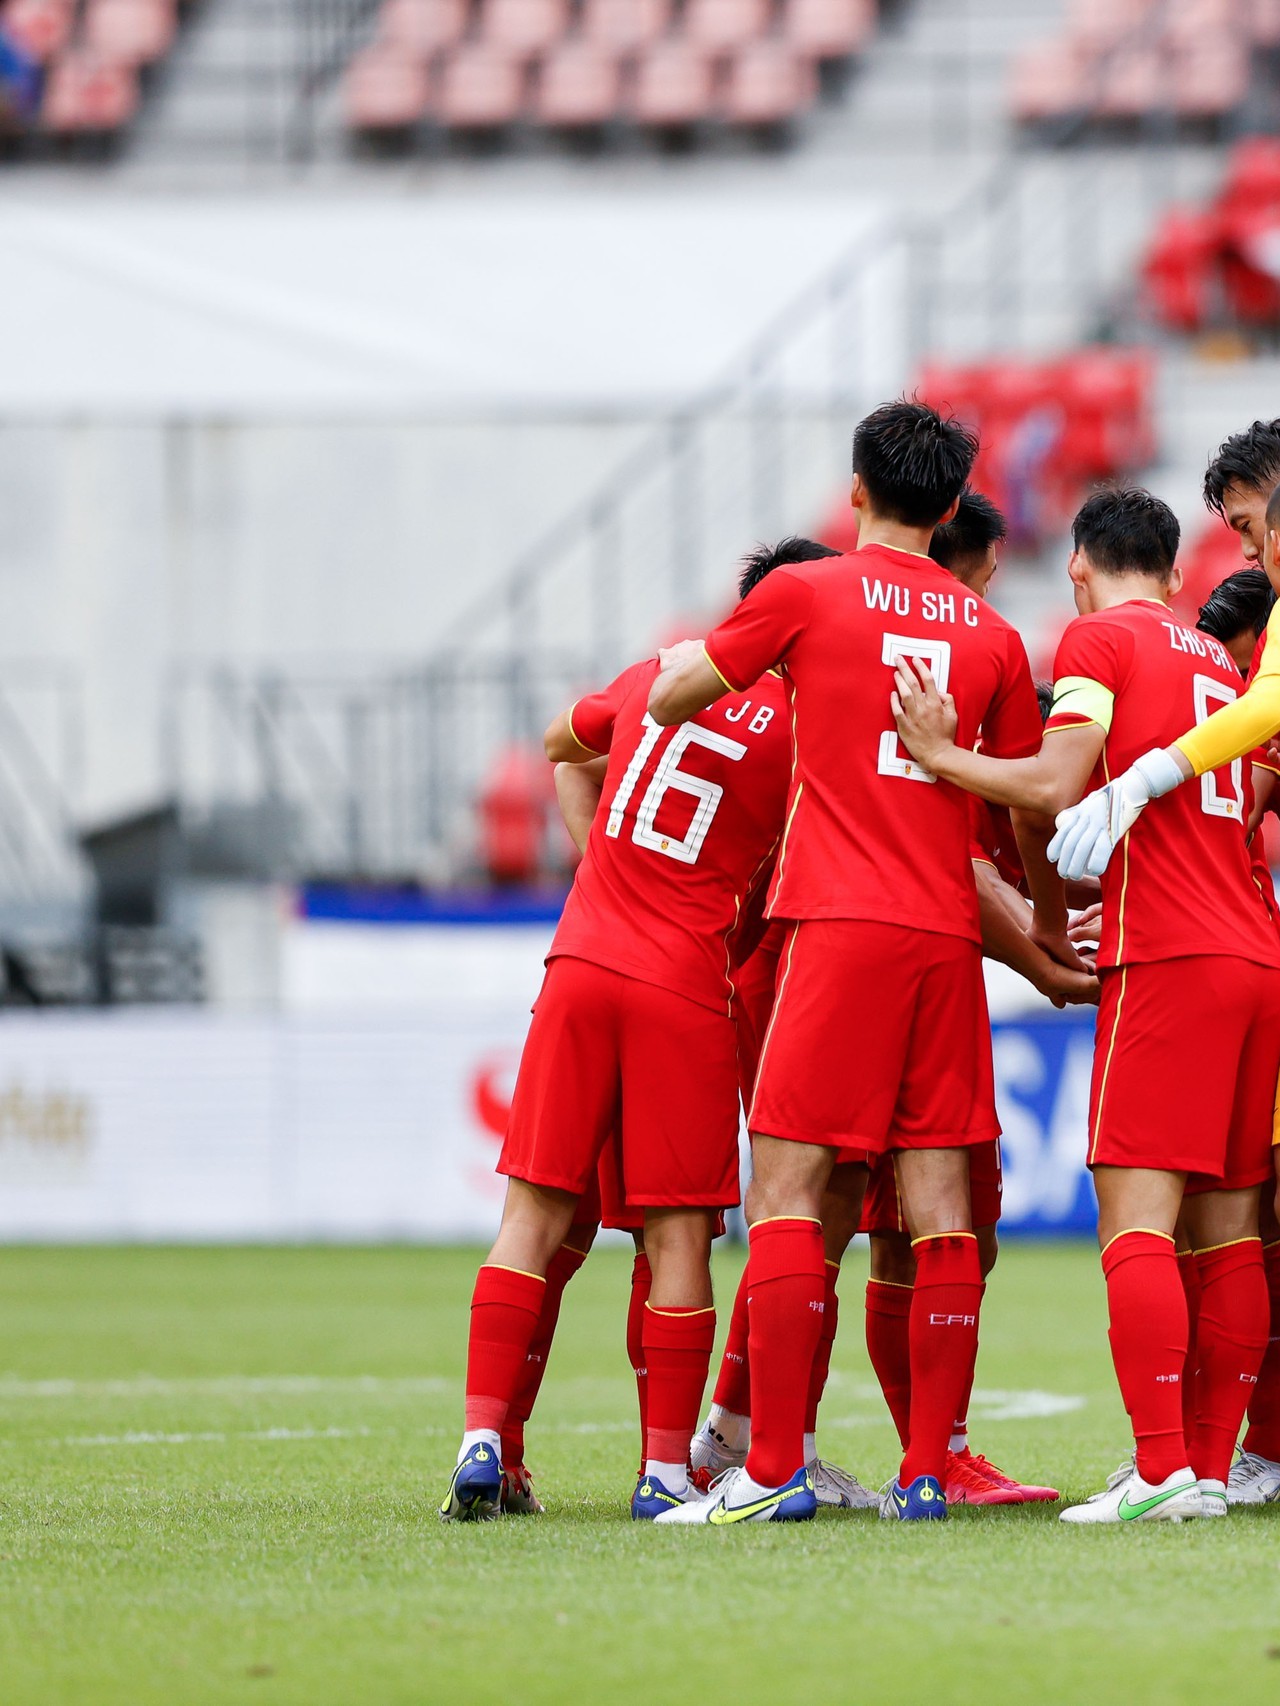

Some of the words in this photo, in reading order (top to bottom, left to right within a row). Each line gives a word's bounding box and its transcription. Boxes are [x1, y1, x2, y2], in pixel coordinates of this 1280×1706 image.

[861, 576, 910, 616] WU
[921, 592, 956, 624] SH
[964, 597, 979, 628] C
[1161, 621, 1207, 658] ZHU
[1205, 639, 1232, 673] CH
[877, 632, 952, 784] 3
[605, 713, 748, 865] 16
[929, 1313, 976, 1327] CFA
